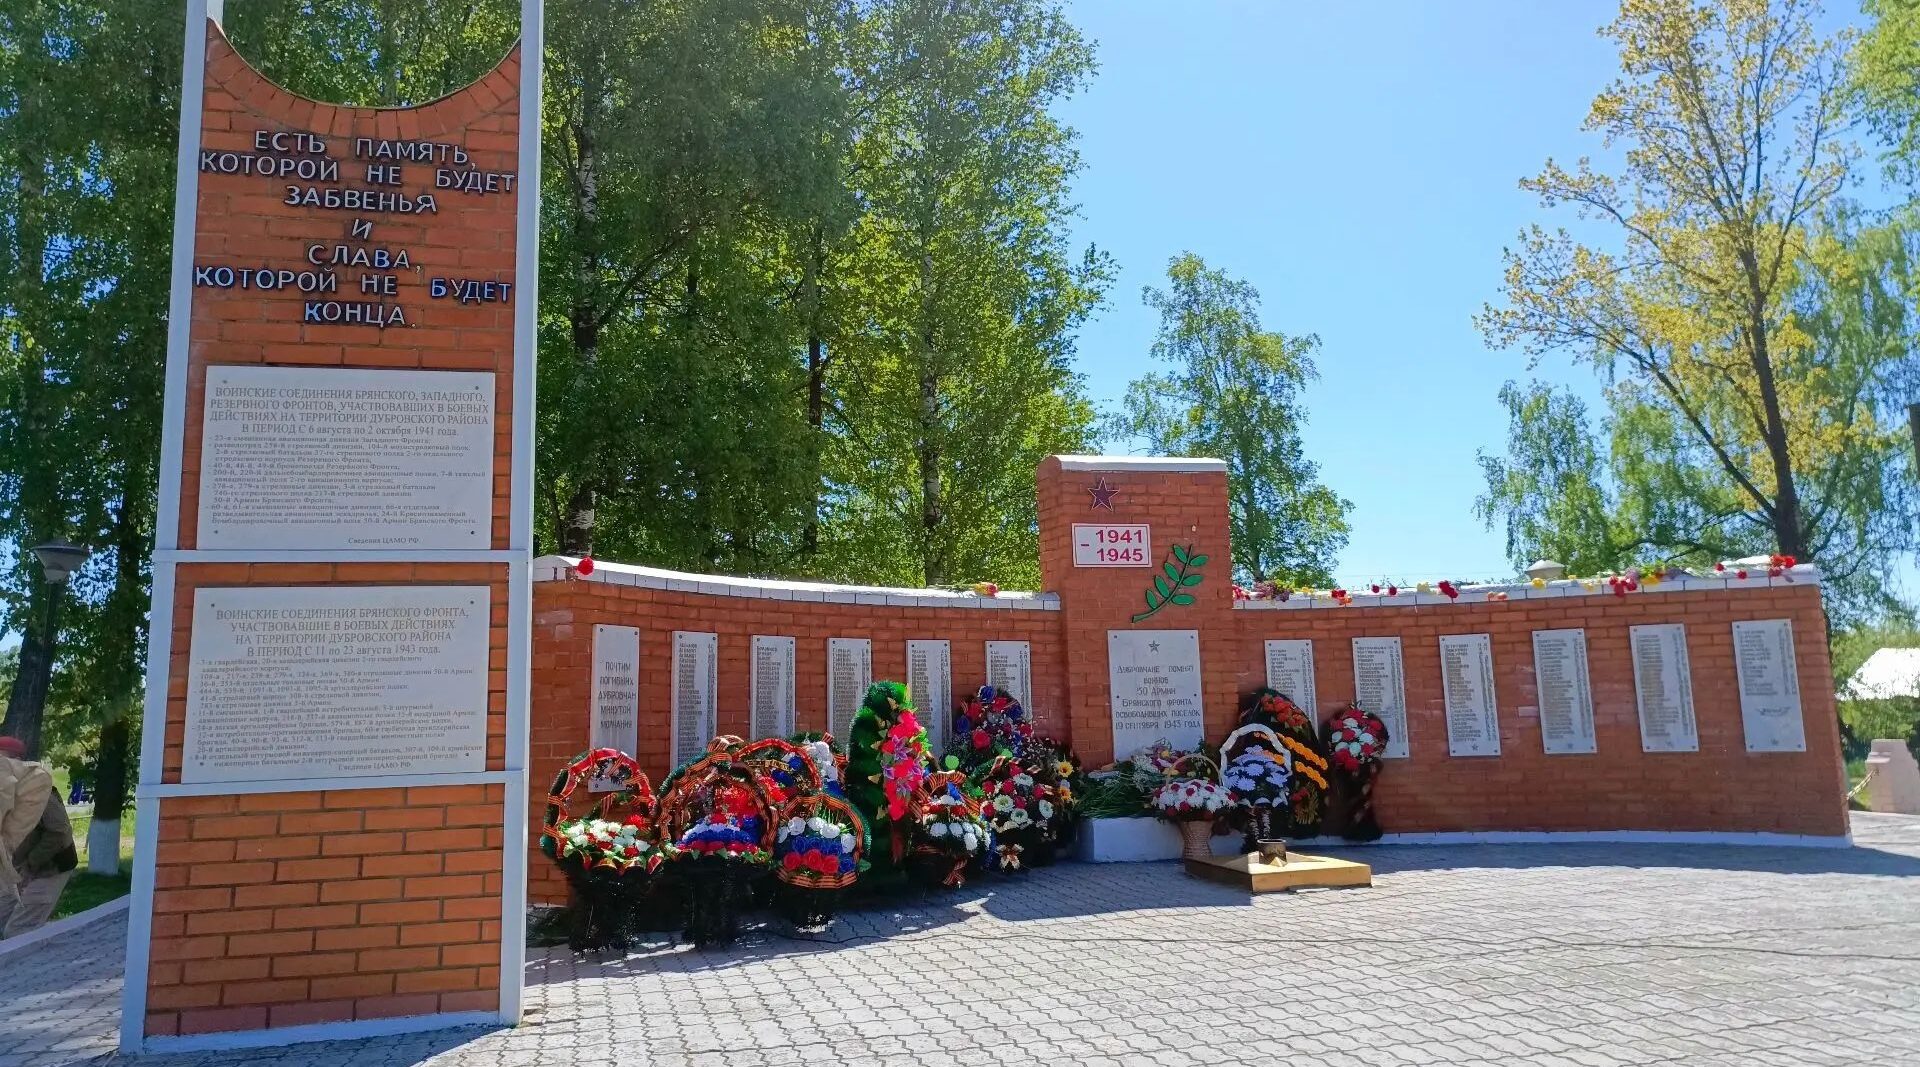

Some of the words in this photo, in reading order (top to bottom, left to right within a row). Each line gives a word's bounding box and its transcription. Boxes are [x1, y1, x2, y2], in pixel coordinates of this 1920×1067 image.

[255, 130, 326, 153] ЕСТЬ
[356, 138, 477, 170] ПАМЯТЬ,
[200, 152, 338, 182] КОТОРОЙ
[367, 164, 402, 185] НЕ
[435, 168, 515, 194] БУДЕТ
[284, 185, 437, 214] ЗАБВЕНЬЯ
[352, 218, 374, 240] И
[308, 244, 422, 273] СЛАВА,
[195, 266, 336, 292] КОТОРОЙ
[361, 273, 397, 296] НЕ
[431, 278, 512, 304] БУДЕТ
[304, 302, 417, 328] КОНЦА.
[215, 387, 276, 398] ВОИНСКИЕ
[279, 388, 352, 400] СОЕДИНЕНИЯ
[355, 389, 419, 402] БРЯНСКОГО,
[421, 391, 486, 403] ЗАПАДНОГО,
[211, 399, 280, 409] РЕЗЕРВНОГО
[283, 400, 337, 412] ФРОНТОВ,
[340, 401, 434, 412] УЧАСТВОВАВШИХ
[447, 403, 489, 413] БОЕВЫХ
[210, 409, 277, 422] ДЕЙСТВИЯХ
[281, 413, 295, 422] НА
[299, 412, 367, 423] ТЕРРИТОРИИ
[370, 414, 445, 425] ДУБРОВСКОГО
[448, 412, 488, 425] РАЙОНА
[1096, 529, 1143, 544] 1941
[1097, 548, 1144, 562] 1945
[216, 609, 279, 620] ВОИНСКИЕ
[281, 608, 356, 620] СОЕДИНЕНИЯ
[359, 607, 421, 618] БРЯНСКОГО
[423, 607, 469, 619] ФРОНТА,
[231, 621, 330, 632] УЧАСТВОВАВШИЕ
[344, 620, 388, 631] БОЕВЫХ
[391, 617, 456, 631] ДЕЙСТВИЯХ
[235, 634, 252, 645] НА
[255, 633, 326, 645] ТЕРРИТОРИИ
[328, 632, 407, 644] ДУБРОВСКОГО
[410, 630, 452, 642] РАЙОНА
